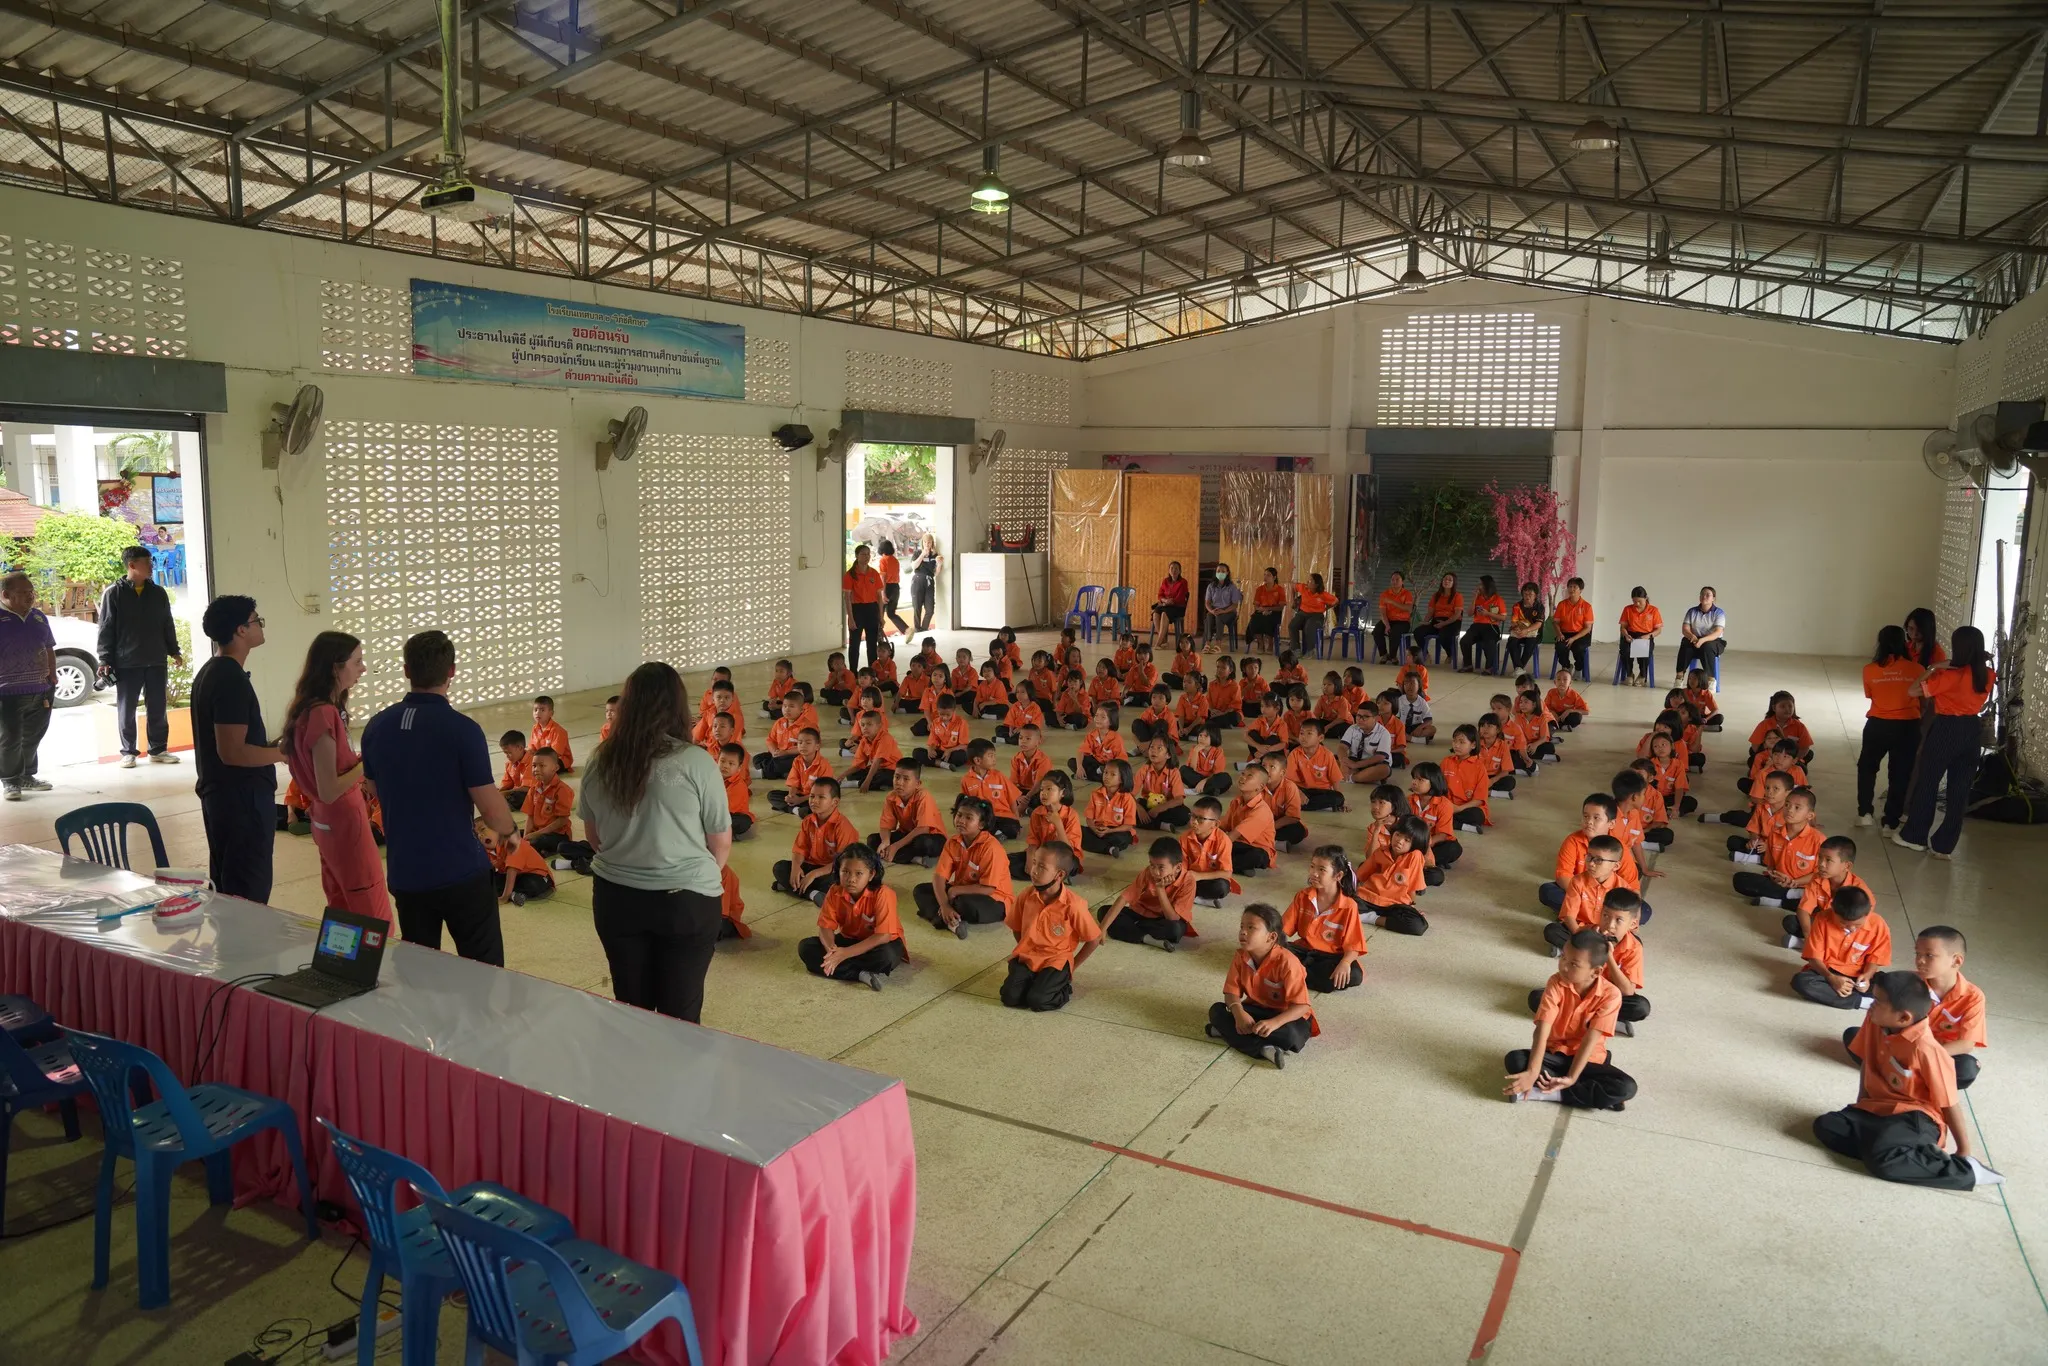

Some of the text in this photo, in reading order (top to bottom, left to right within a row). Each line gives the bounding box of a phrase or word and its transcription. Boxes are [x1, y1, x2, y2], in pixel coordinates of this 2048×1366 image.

[457, 328, 526, 345] ประธานในพิธี
[529, 334, 573, 350] ผู้มีเกียรติ
[572, 325, 629, 343] ขอต้อนรับ
[512, 348, 596, 367] ผู้ปกครองนักเรียน
[565, 369, 638, 385] ด้วยความยินดียิ่ง
